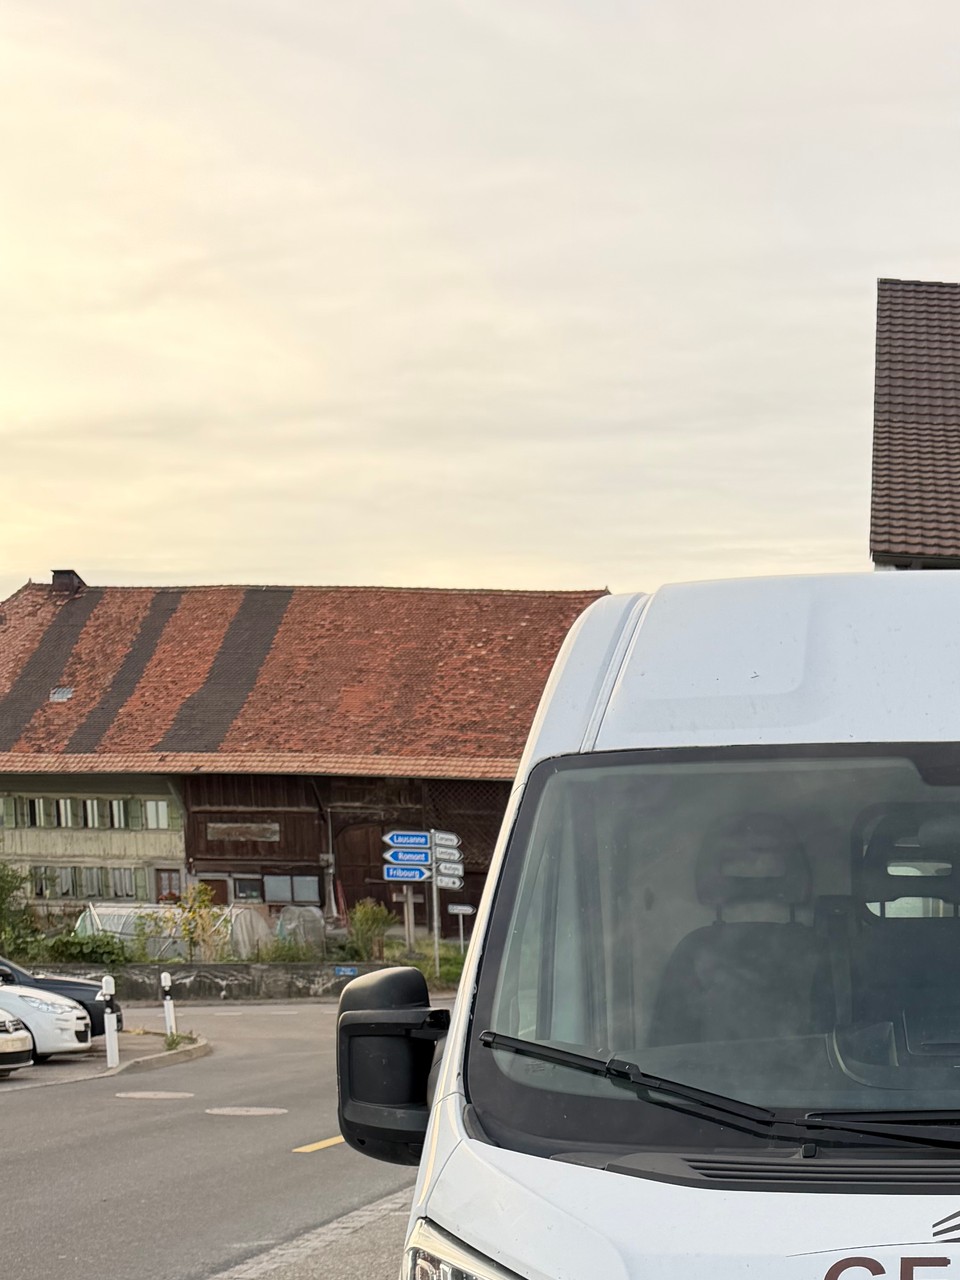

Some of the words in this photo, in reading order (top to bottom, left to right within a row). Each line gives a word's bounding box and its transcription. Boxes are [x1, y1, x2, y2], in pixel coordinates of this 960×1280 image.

[393, 834, 426, 844] Lausanne
[398, 851, 426, 861] Romont
[389, 867, 420, 879] Fribourg
